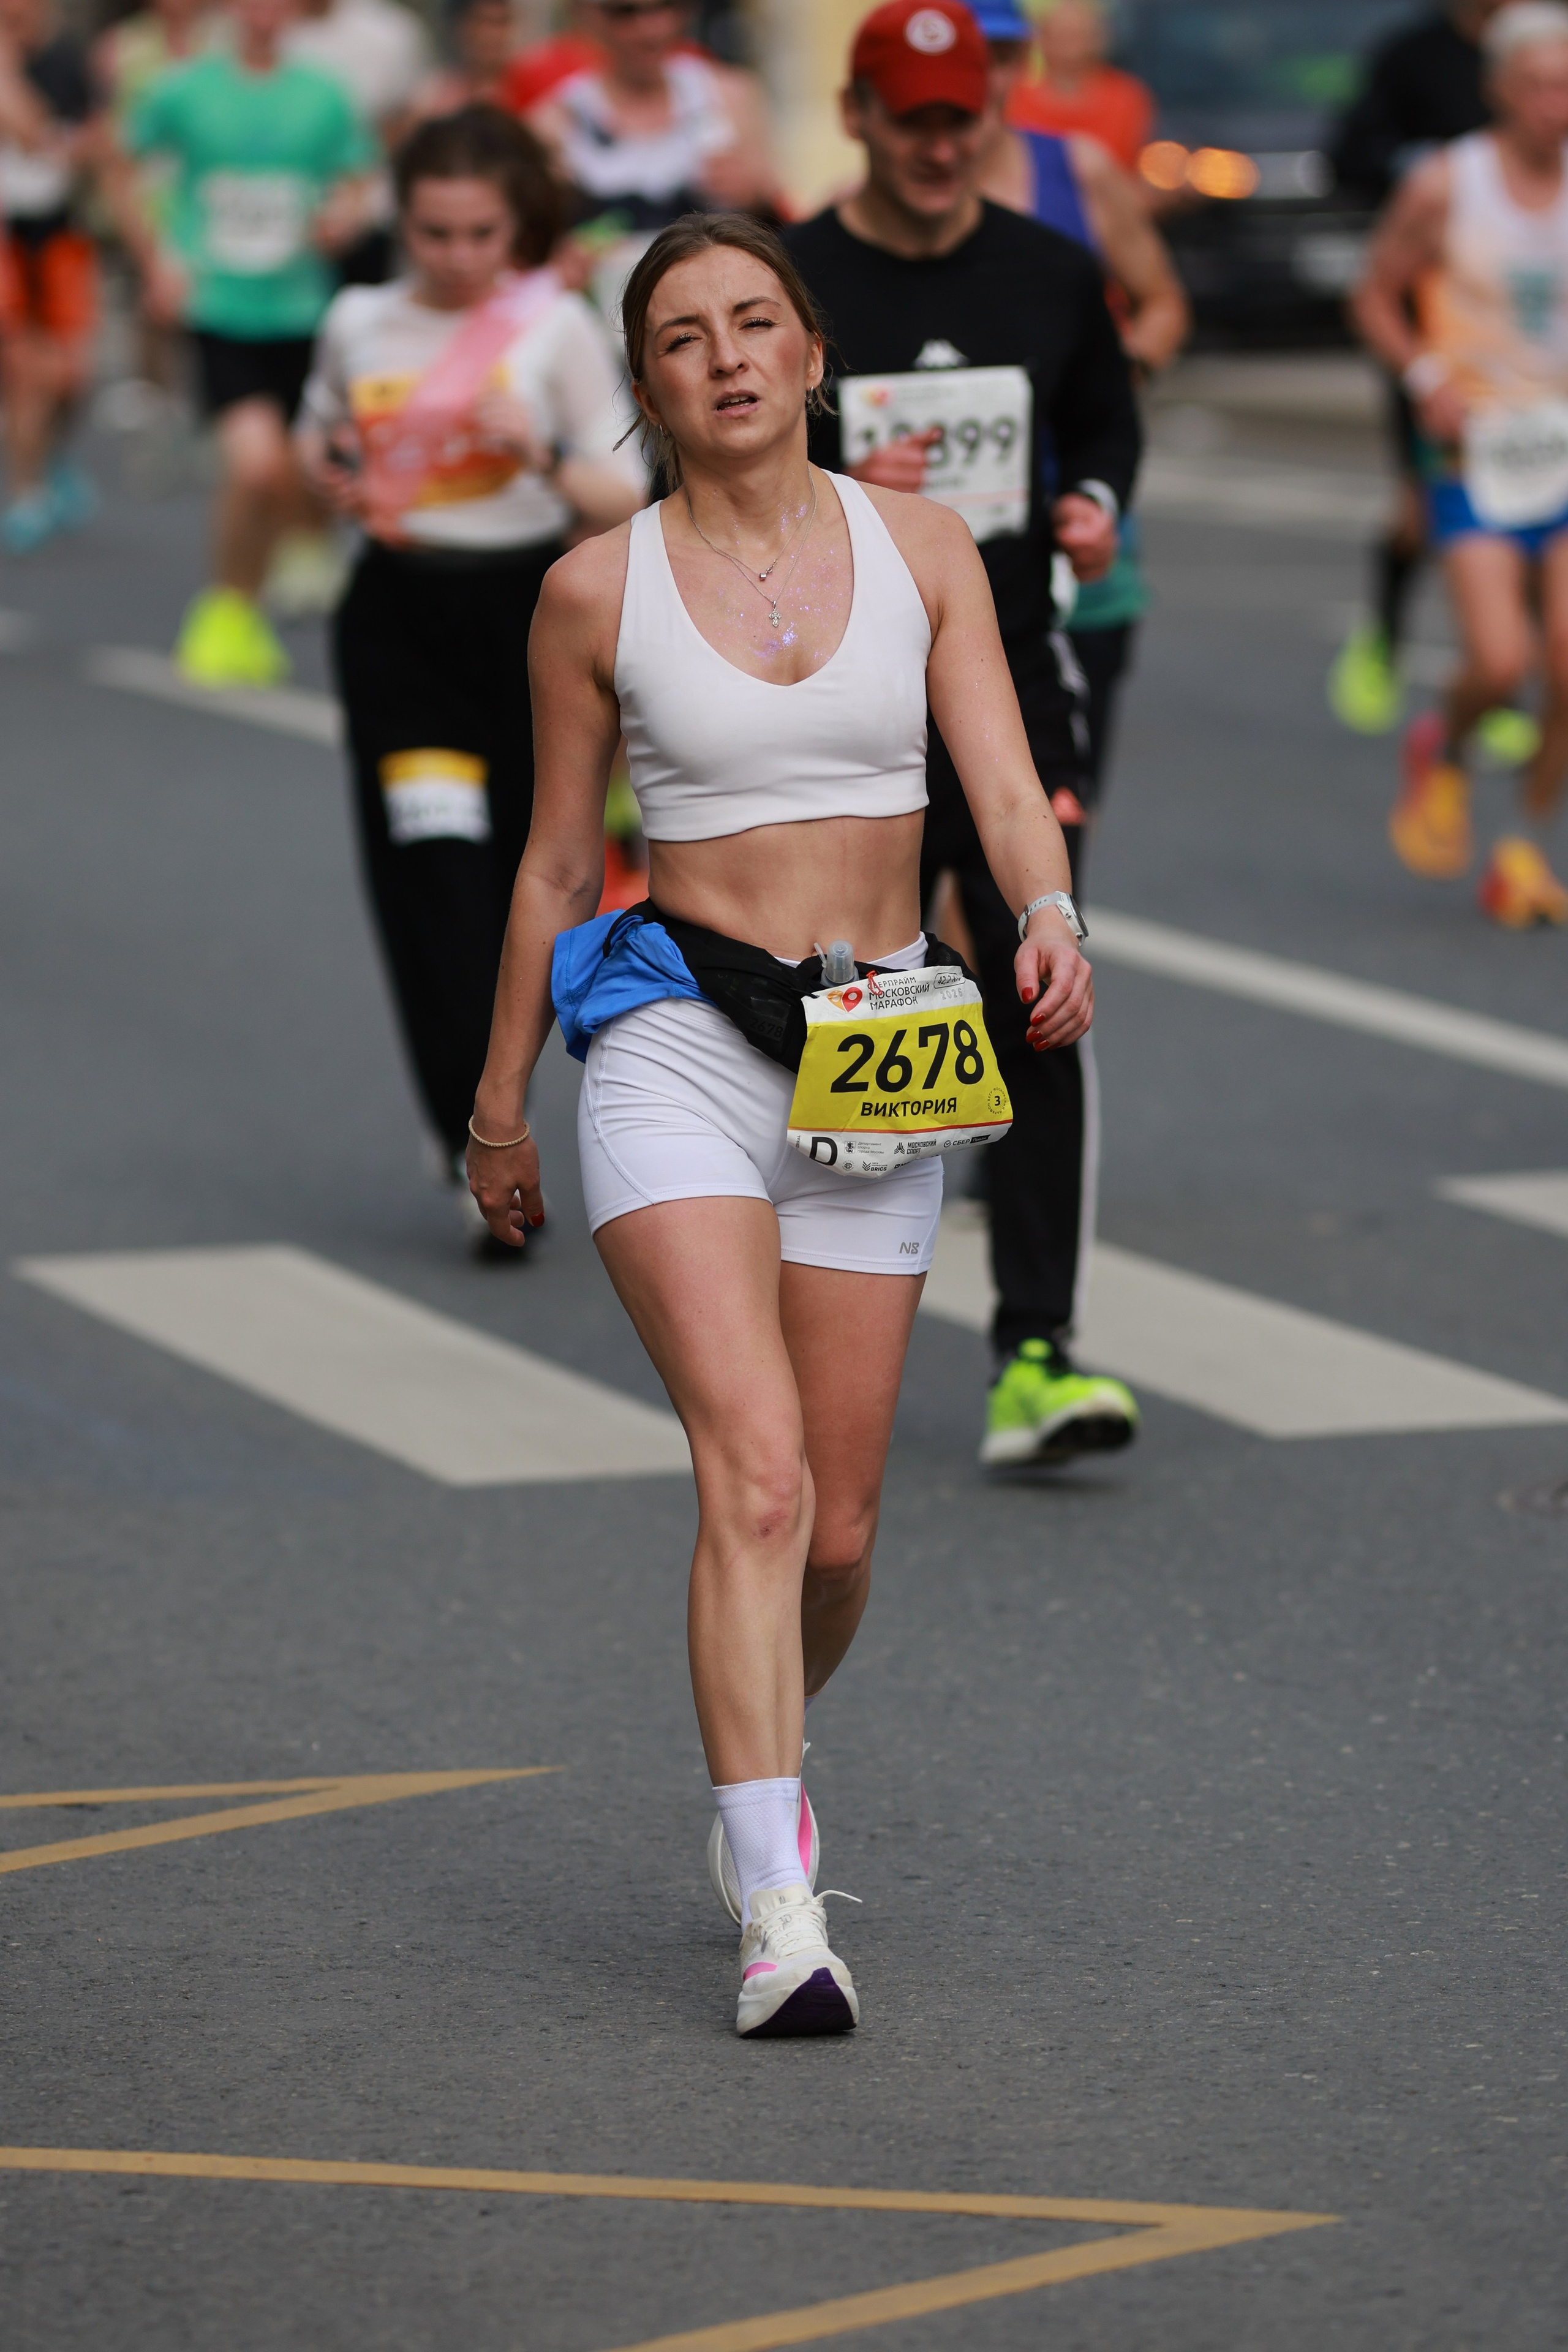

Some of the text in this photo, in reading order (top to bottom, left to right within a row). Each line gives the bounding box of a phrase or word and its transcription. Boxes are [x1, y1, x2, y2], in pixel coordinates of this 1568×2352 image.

[869, 982, 930, 1000] МОСКОВСКИЙ
[870, 995, 918, 1011] МАРАФОН
[748, 1018, 783, 1038] 2678
[830, 1019, 984, 1093] 2678
[861, 1097, 957, 1117] ВИКТОРИЯ
[994, 1095, 1001, 1106] 3
[809, 1136, 839, 1166] D
[907, 1139, 937, 1148] МОСКОВСКИЙ
